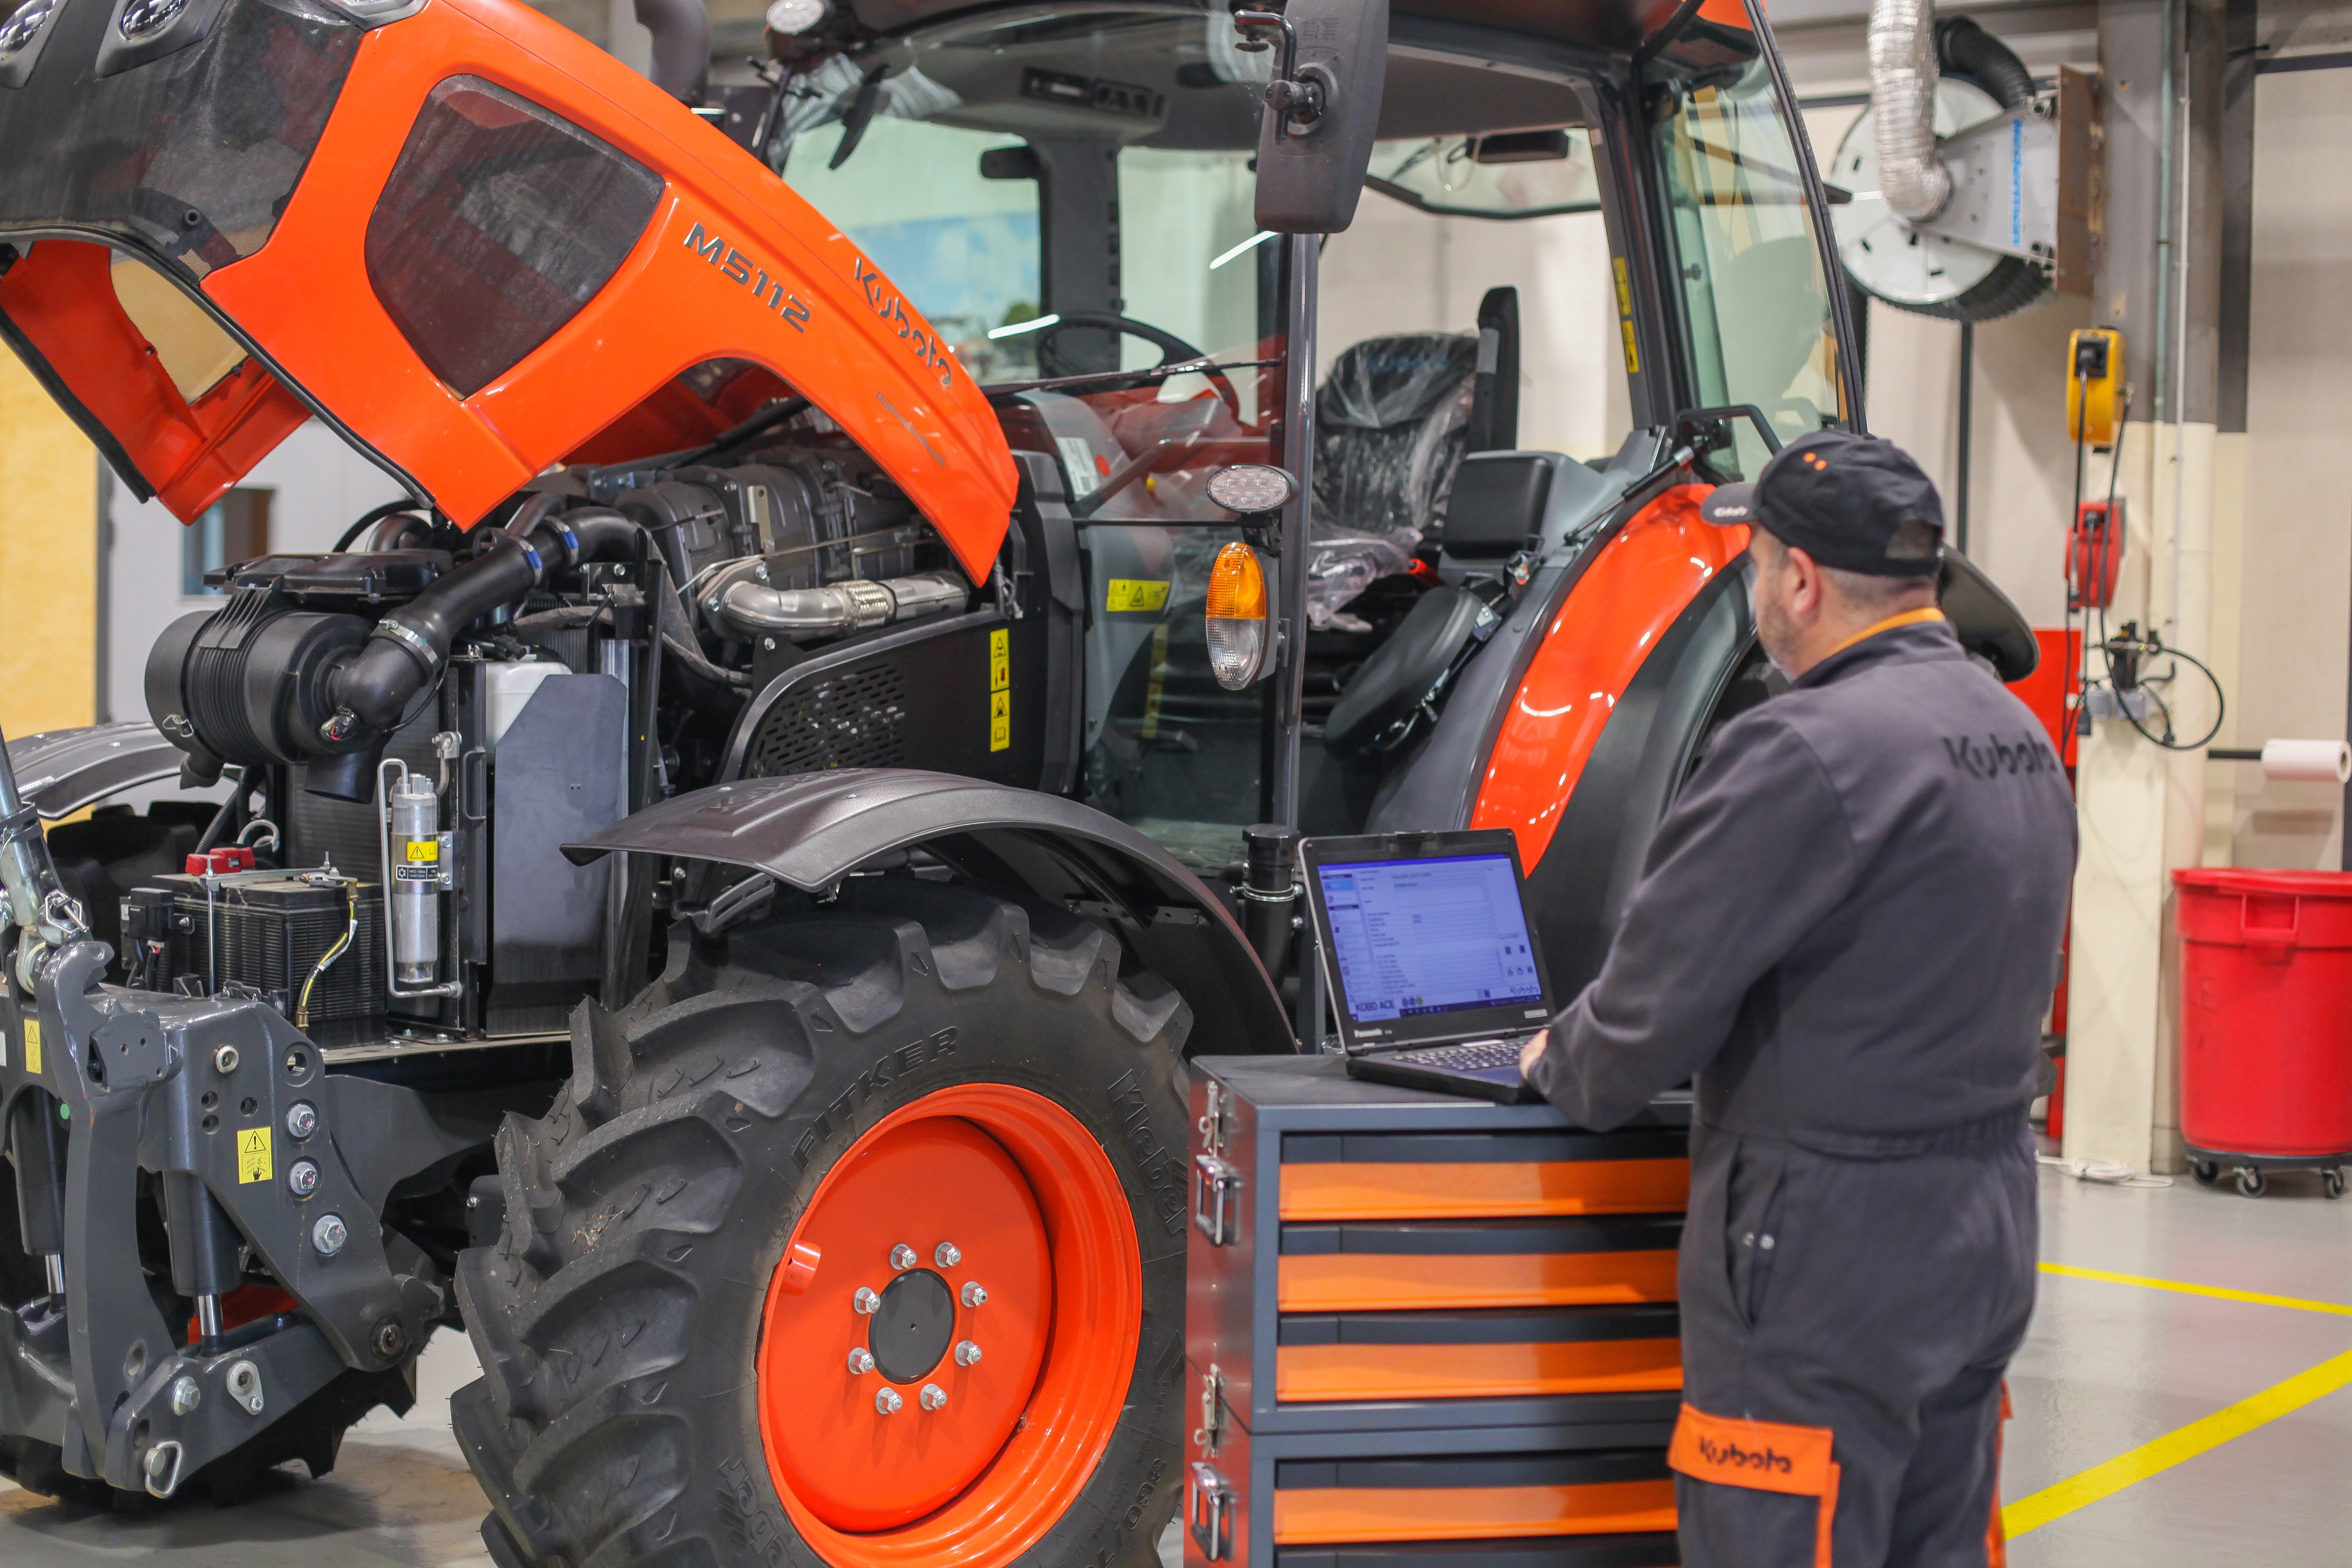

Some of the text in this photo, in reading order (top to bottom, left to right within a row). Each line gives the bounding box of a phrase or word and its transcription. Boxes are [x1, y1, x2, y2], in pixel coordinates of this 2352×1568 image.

[683, 222, 810, 333] M5112
[854, 256, 951, 389] Kubota
[1942, 730, 2058, 779] Kubota
[791, 1026, 958, 1171] FITKER
[1108, 1068, 1188, 1238] Kleber
[1700, 1436, 1792, 1473] Kubota
[1086, 1458, 1166, 1568] 360/7
